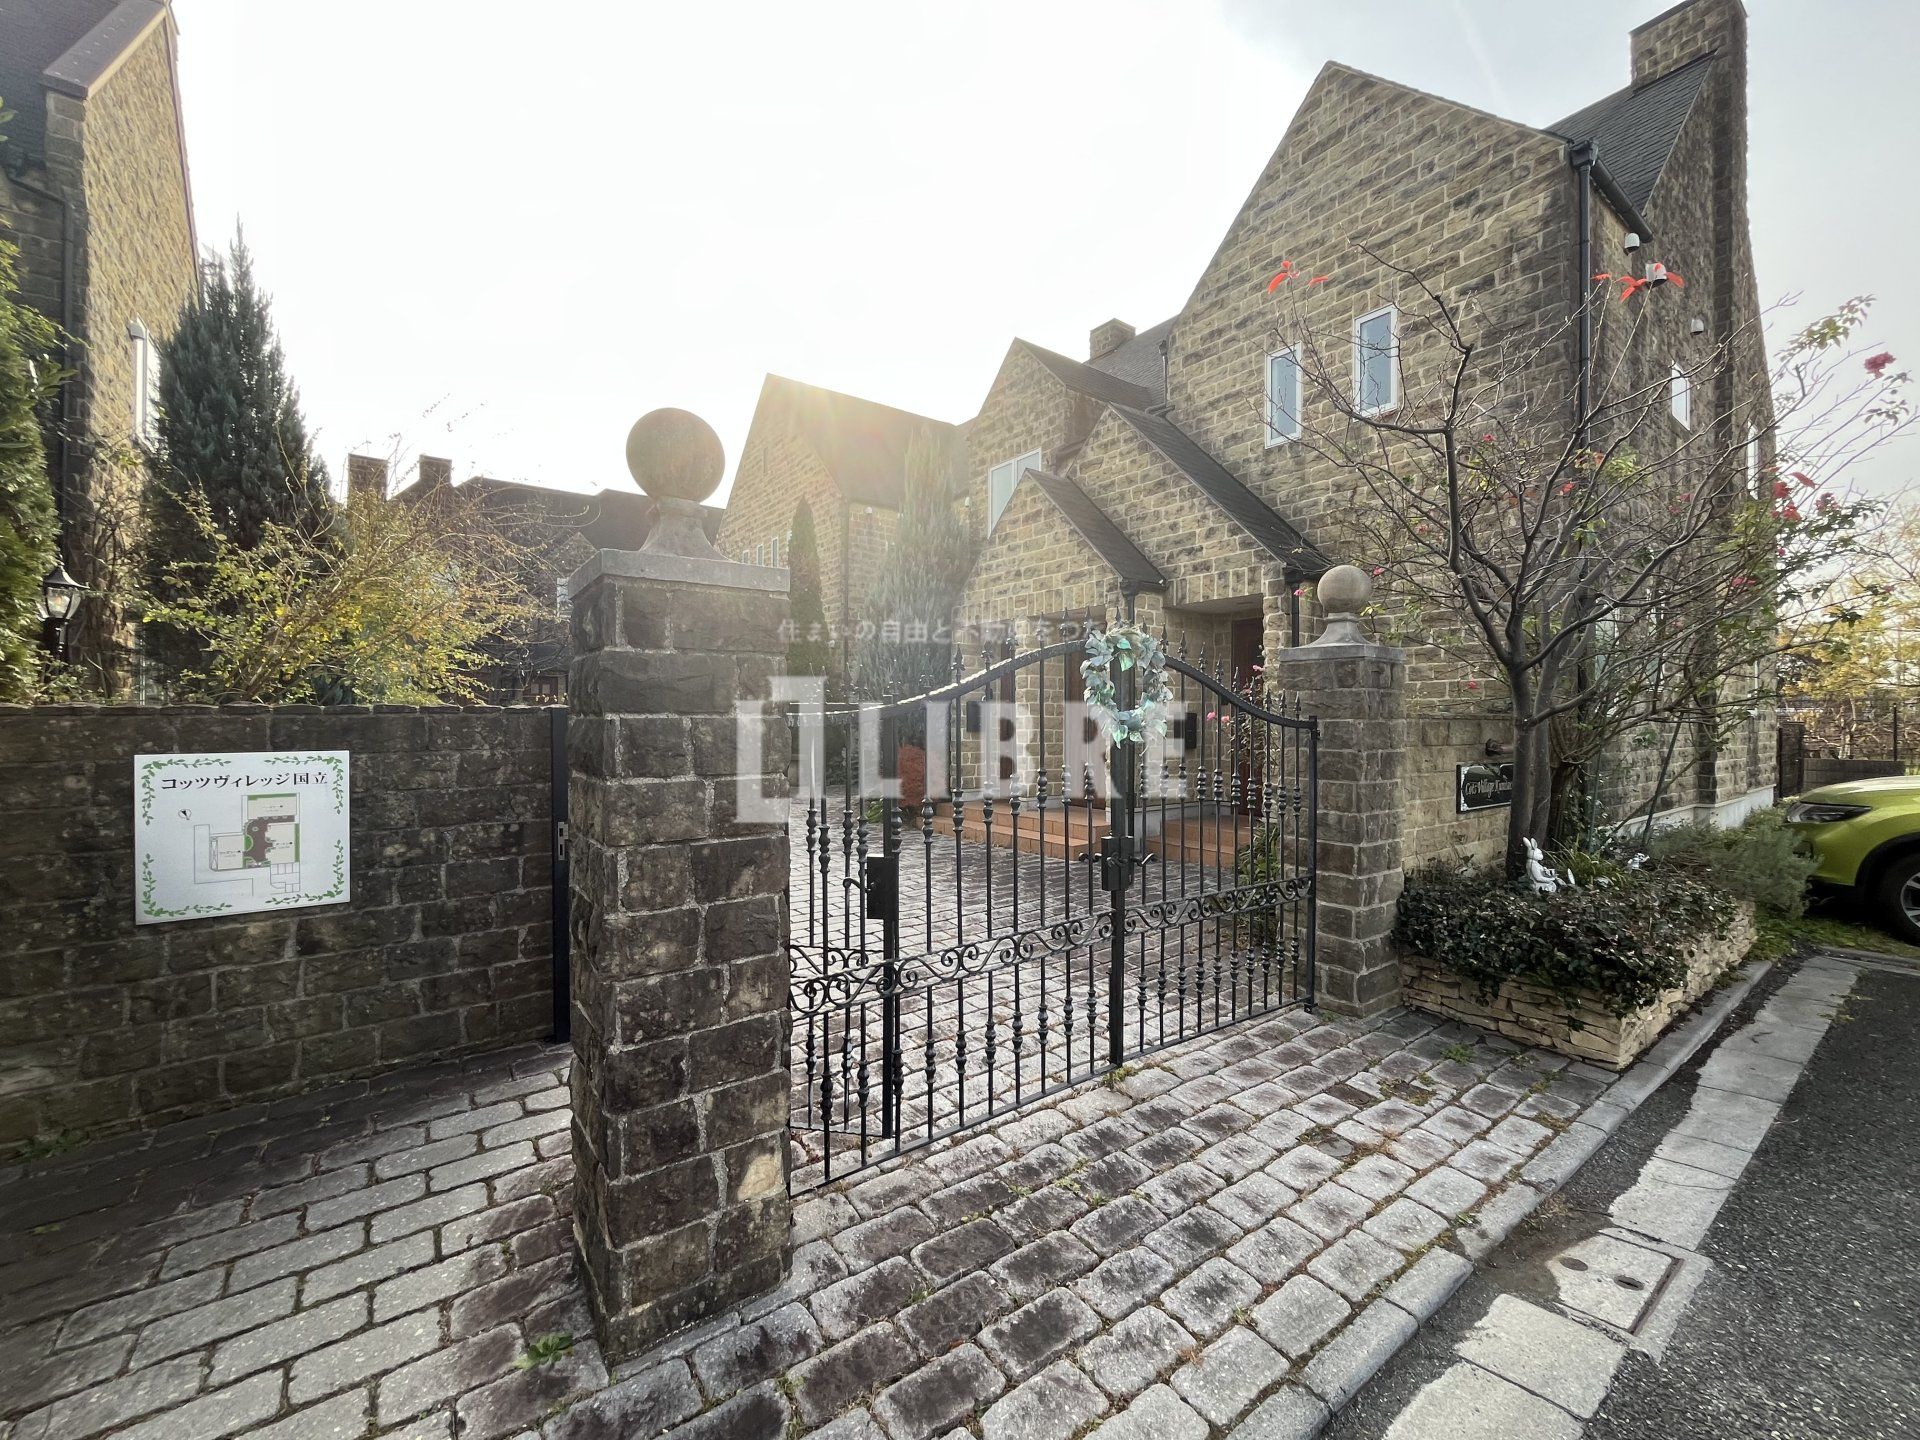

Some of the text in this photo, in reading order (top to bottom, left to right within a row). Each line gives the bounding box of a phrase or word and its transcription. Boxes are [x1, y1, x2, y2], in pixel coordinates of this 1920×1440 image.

[161, 771, 328, 790] コッツヴィレッジ国立
